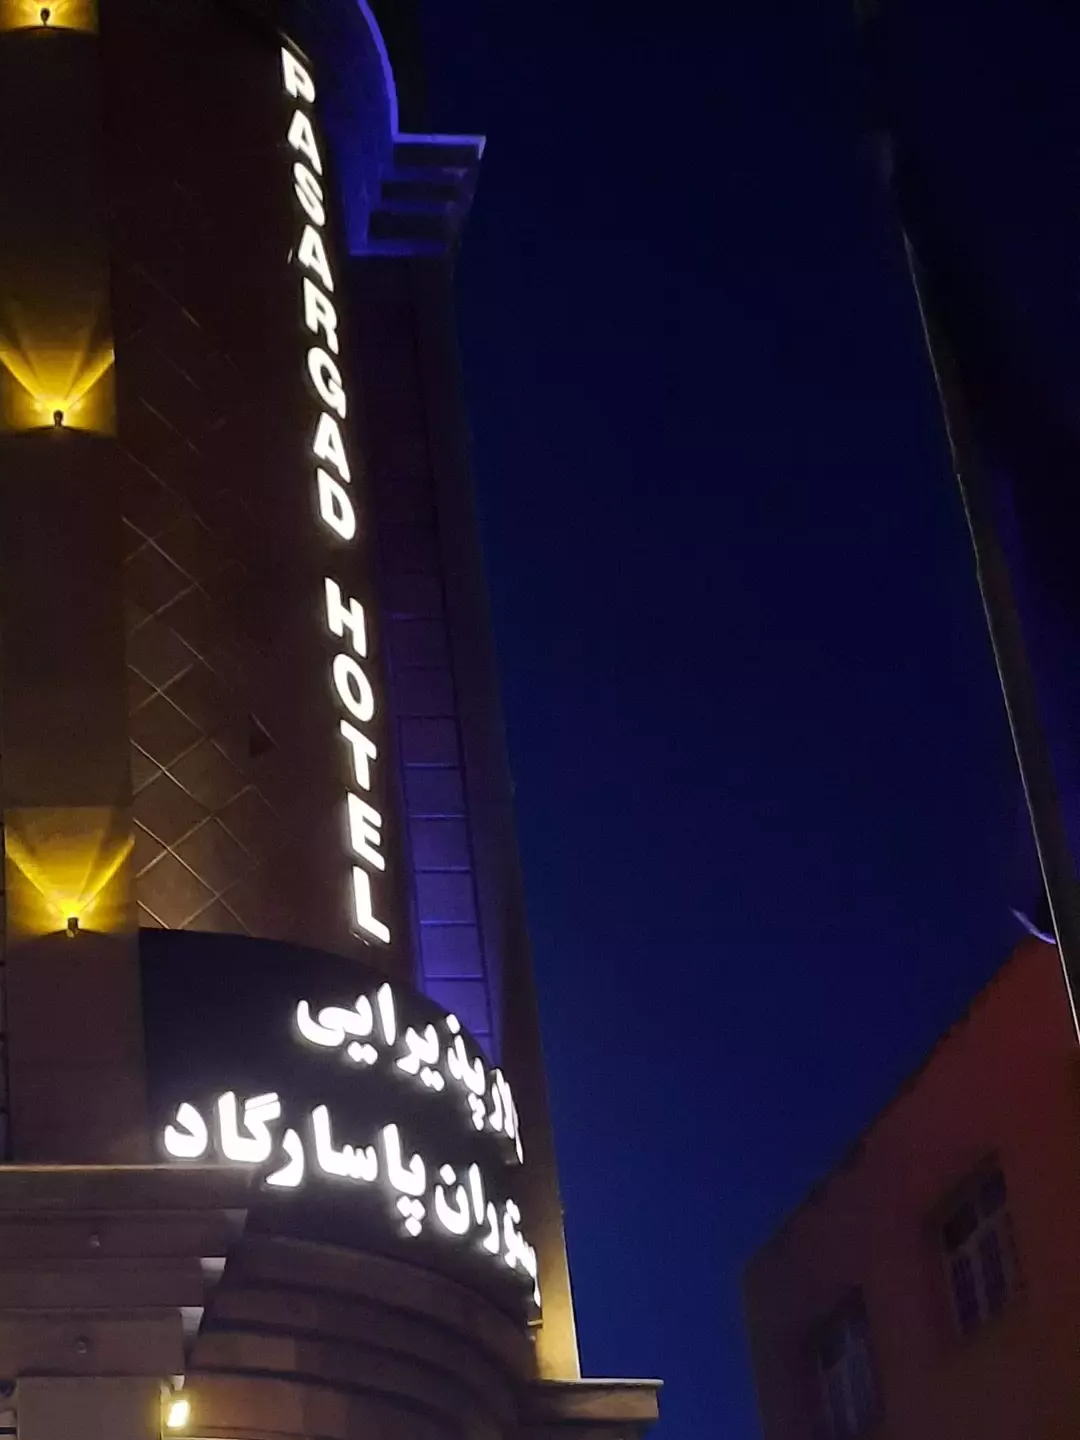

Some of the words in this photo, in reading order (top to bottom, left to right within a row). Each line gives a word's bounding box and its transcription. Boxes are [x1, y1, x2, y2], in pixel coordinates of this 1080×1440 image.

[281, 47, 356, 541] PASARGAD
[325, 577, 391, 944] HOTEL
[163, 1090, 426, 1237] پاسارگاد
